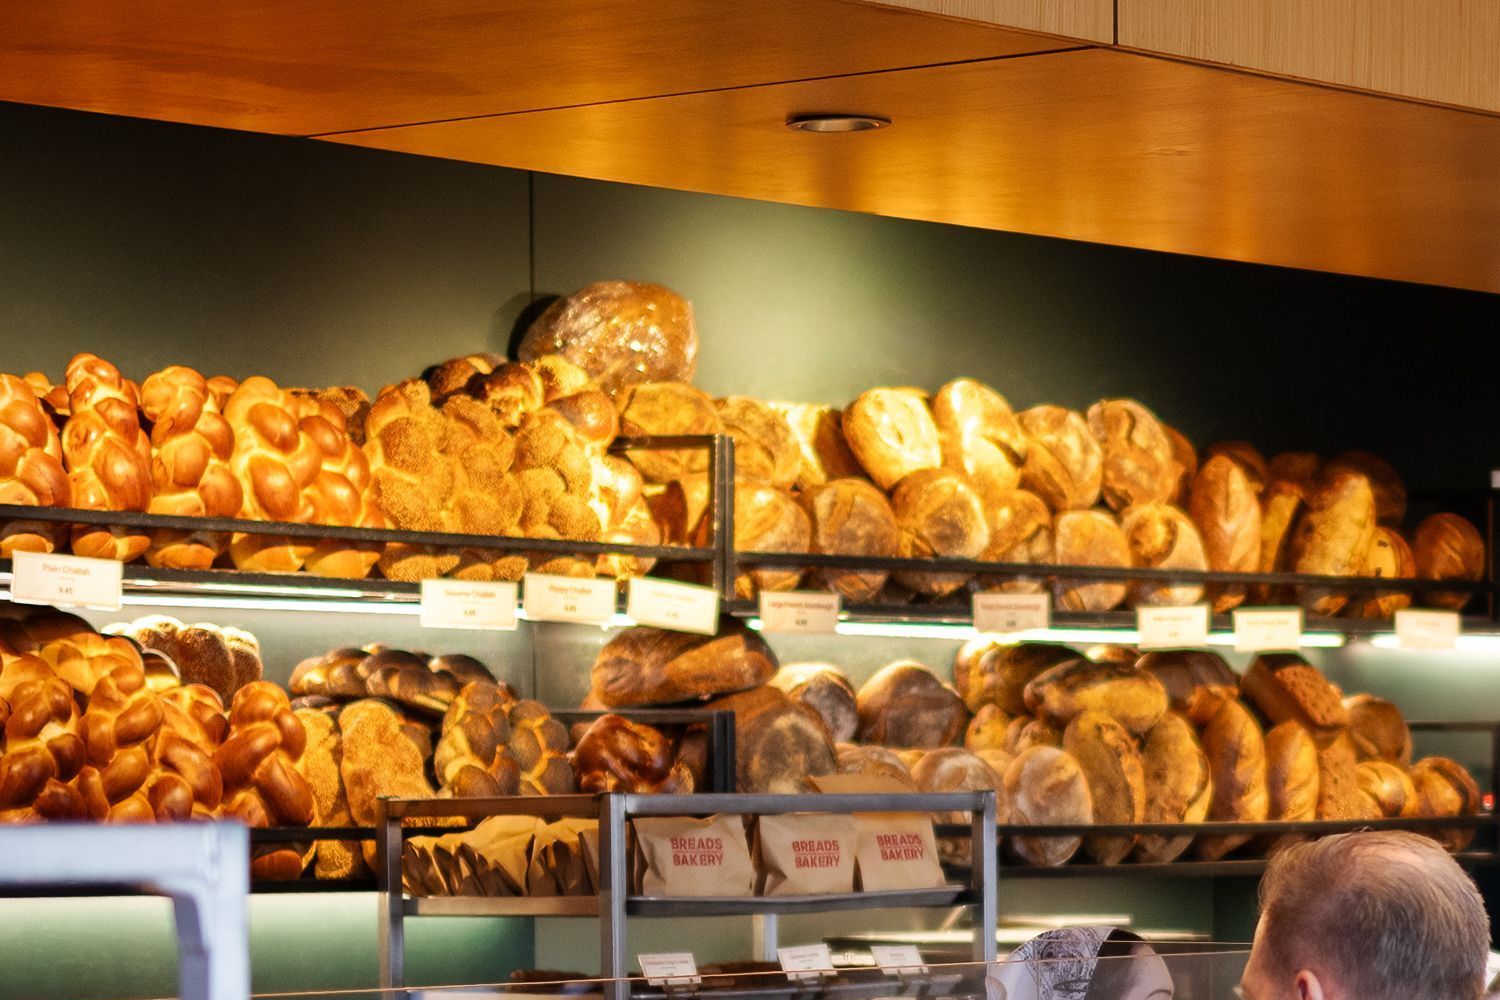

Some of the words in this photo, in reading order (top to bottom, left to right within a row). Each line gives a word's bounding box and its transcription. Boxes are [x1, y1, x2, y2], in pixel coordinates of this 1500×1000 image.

[670, 837, 723, 850] BREADS
[791, 840, 840, 853] BREADS
[876, 834, 922, 847] BREADS
[672, 853, 723, 867] BAKERY
[880, 847, 924, 861] BAKERY
[794, 855, 840, 869] BAKERY
